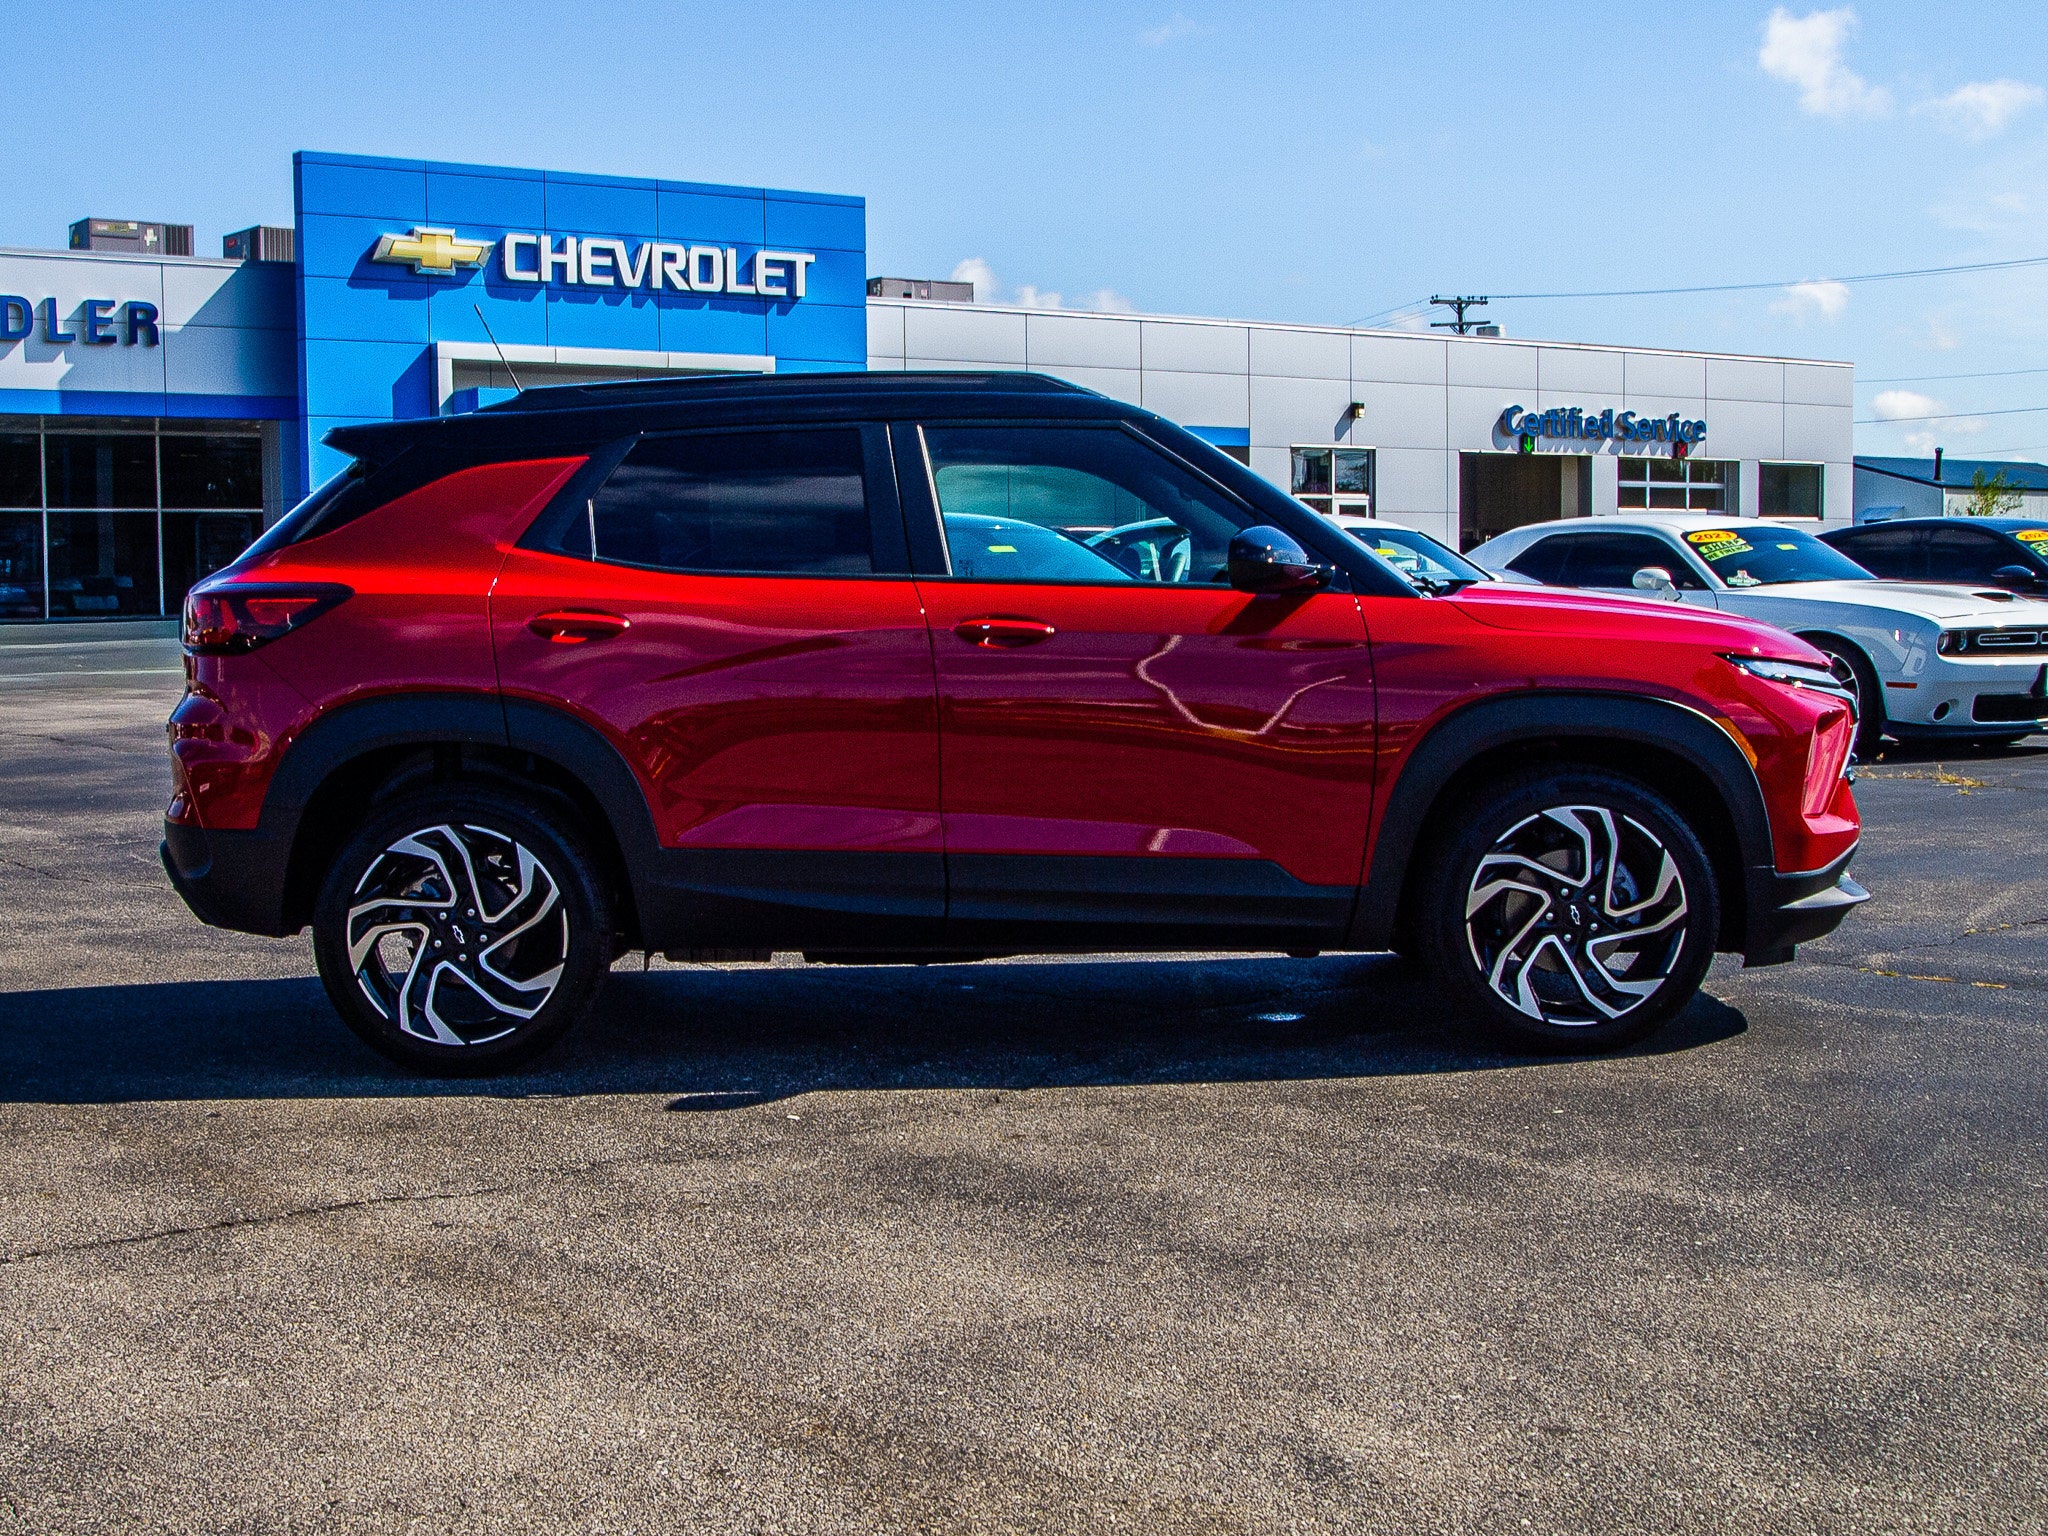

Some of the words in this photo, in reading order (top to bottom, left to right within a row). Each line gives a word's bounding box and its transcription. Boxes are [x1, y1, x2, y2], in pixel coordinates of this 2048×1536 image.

[503, 232, 816, 297] CHEVROLET
[0, 295, 160, 346] DLER
[1506, 404, 1614, 437] Certified
[1622, 410, 1707, 442] Service
